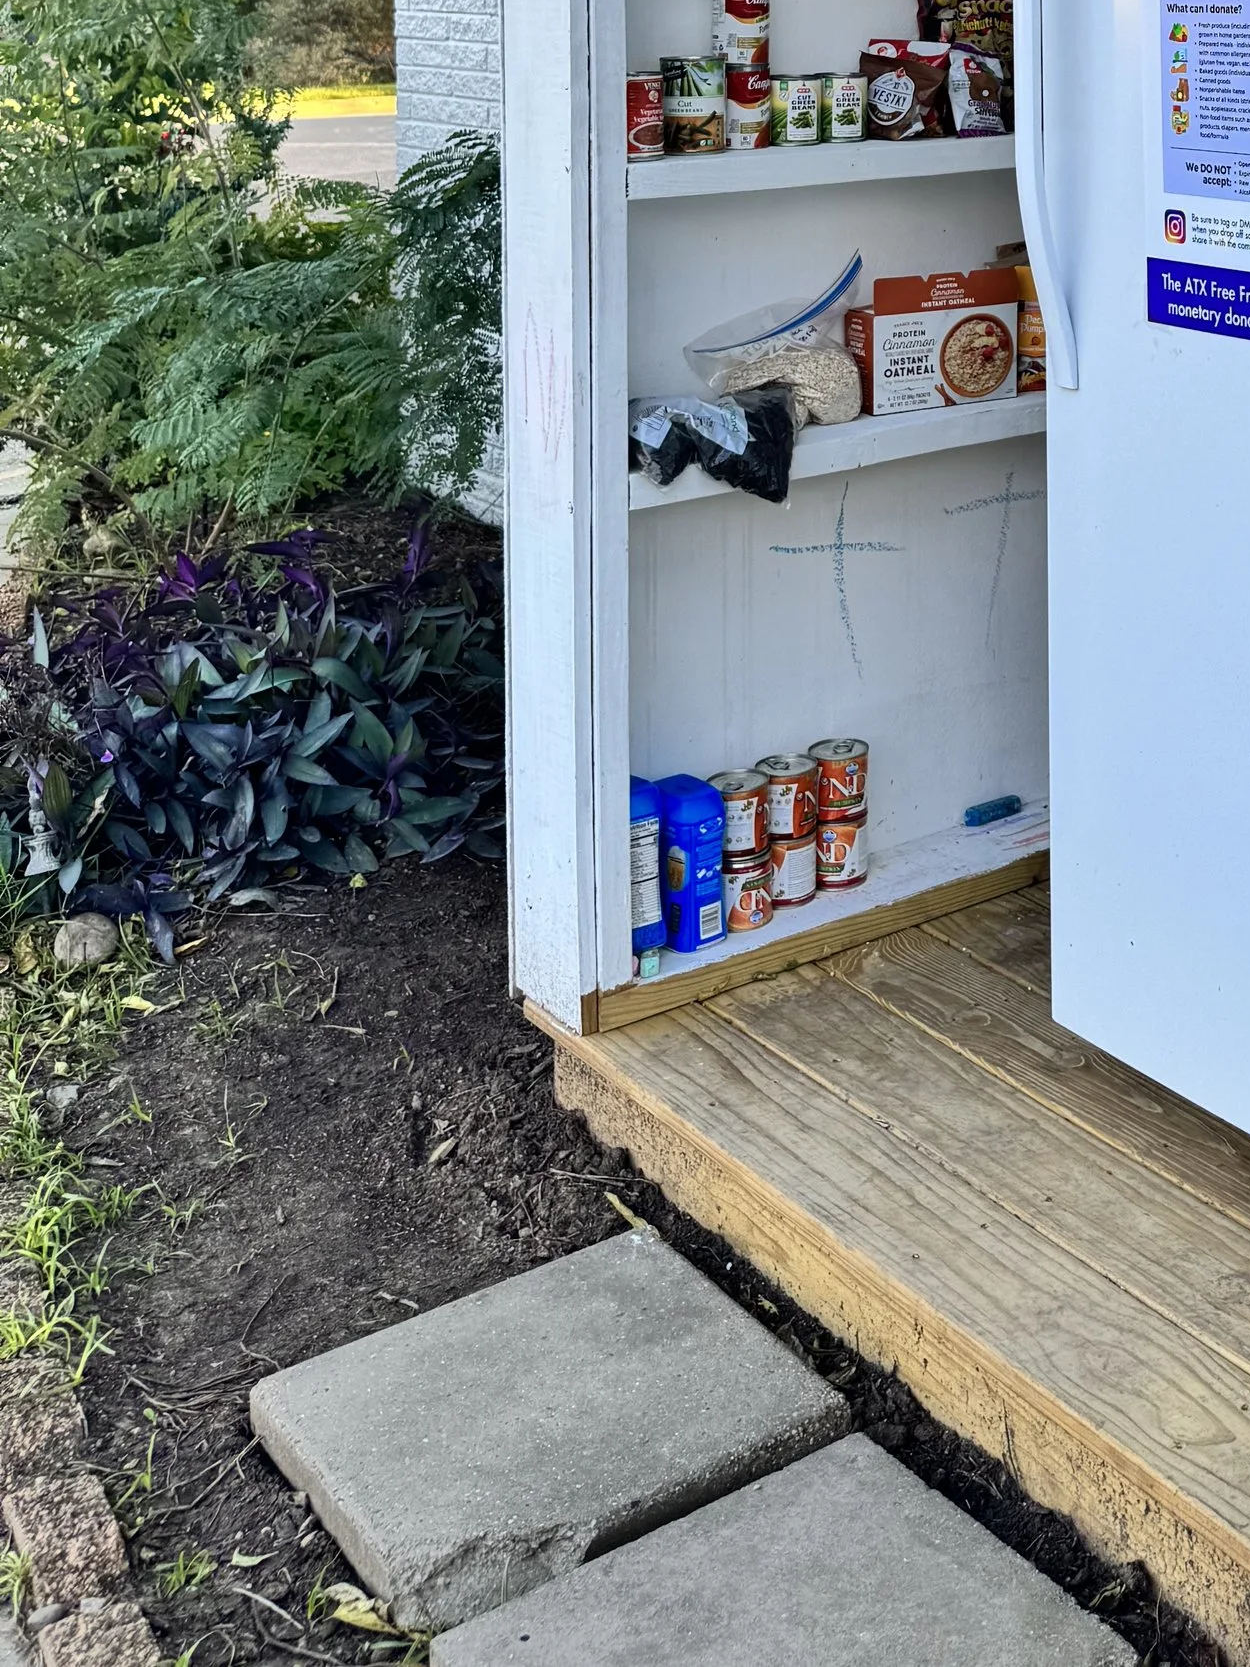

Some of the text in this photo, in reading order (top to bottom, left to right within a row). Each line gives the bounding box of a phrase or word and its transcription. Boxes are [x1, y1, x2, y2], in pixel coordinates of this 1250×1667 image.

[1167, 4, 1188, 13] What
[1210, 5, 1242, 14] donate?
[1186, 162, 1231, 175] We DO NOT
[1203, 176, 1231, 188] accept:
[1192, 213, 1199, 222] Be
[1220, 218, 1230, 228] tag
[1240, 220, 1250, 228] DM
[1192, 225, 1206, 233] when
[1208, 228, 1219, 236] you
[1220, 228, 1234, 238] drop
[1192, 236, 1207, 245] share
[1214, 238, 1226, 246] with
[1227, 239, 1236, 248] the
[931, 288, 964, 296] Cinnamon
[1162, 273, 1181, 292] The
[1185, 277, 1207, 297] ATX
[1211, 281, 1235, 302] Free
[922, 297, 975, 308] INSTANT OATMEAL
[1168, 302, 1221, 327] monetary
[893, 330, 926, 338] PROTEIN
[883, 339, 935, 351] Cinnamon
[890, 356, 929, 366] INSTANT
[884, 364, 935, 378] OATMEAL
